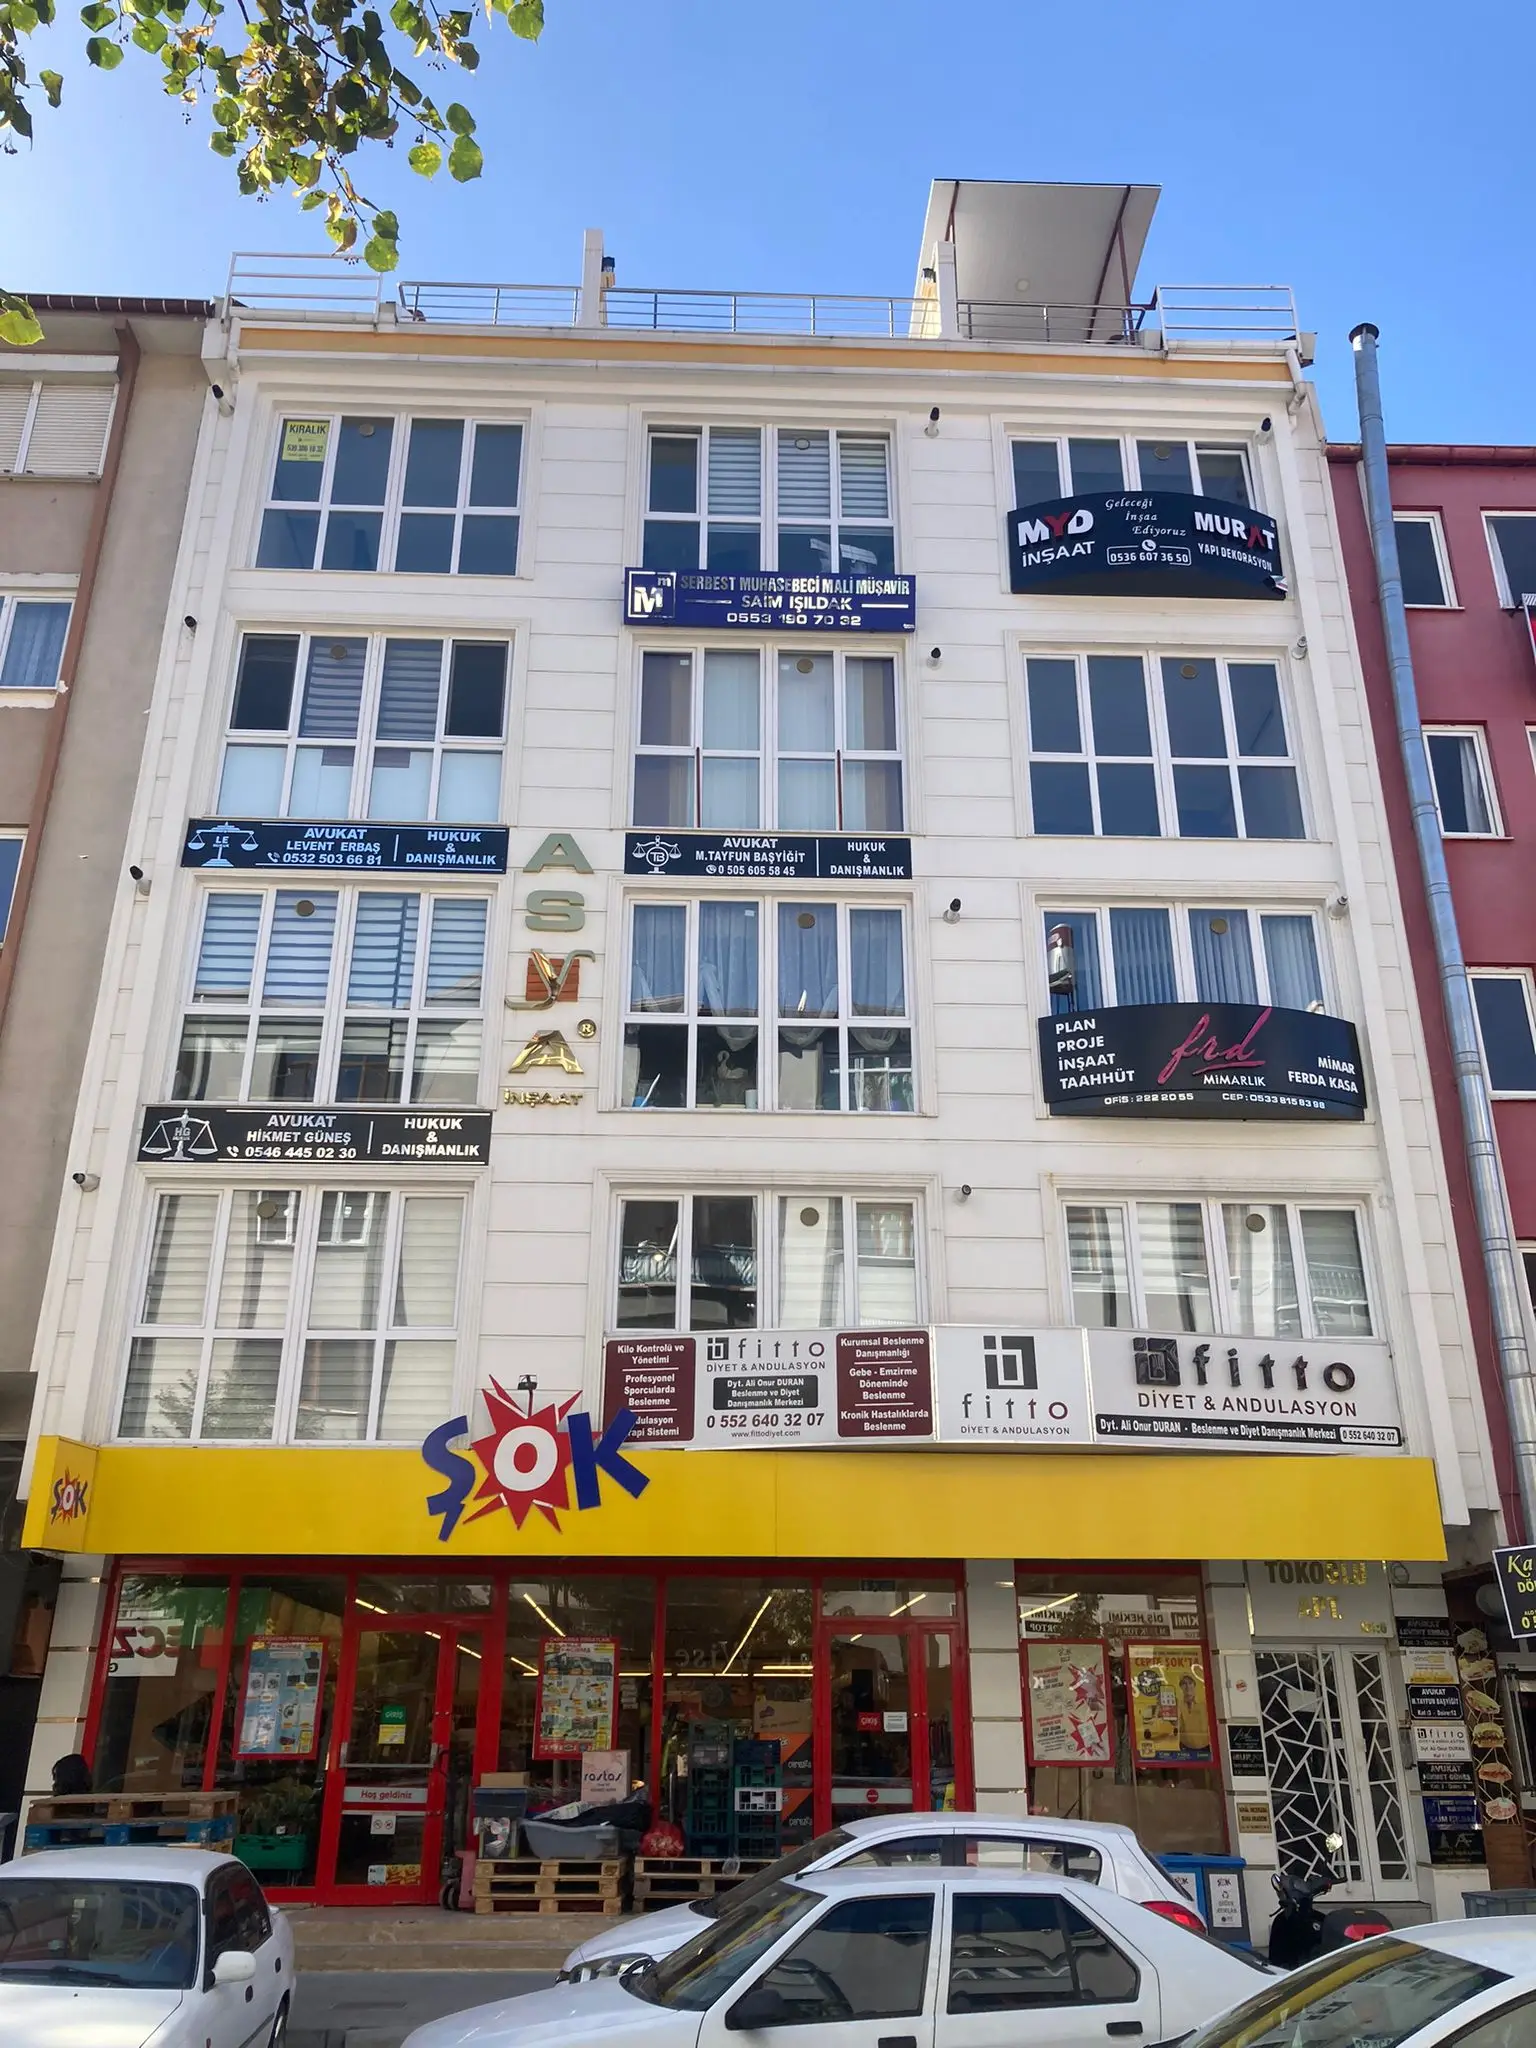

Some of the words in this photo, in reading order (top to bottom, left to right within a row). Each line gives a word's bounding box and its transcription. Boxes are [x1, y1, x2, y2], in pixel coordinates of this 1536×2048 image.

[1105, 498, 1153, 510] Geleceği
[1126, 511, 1157, 522] İnşaa
[1017, 510, 1094, 546] MYD
[1132, 525, 1187, 538] Ediyoruz
[1194, 511, 1276, 550] MURAT
[1022, 541, 1095, 567] İNŞAAT
[1110, 552, 1136, 562] 0536
[1139, 551, 1158, 561] 607
[1160, 552, 1174, 562] 36
[1176, 552, 1188, 563] 50
[1198, 543, 1218, 556] YAPI
[1220, 547, 1272, 572] DEKORASYON
[680, 575, 736, 592] SERBEST
[740, 575, 820, 594] MUHASEBECİ
[822, 577, 853, 595] MALİ
[855, 577, 910, 598] MÜŞAVİR
[741, 592, 782, 609] SAİM
[790, 596, 852, 614] IŞILDAK
[726, 612, 772, 624] 0553
[814, 614, 834, 625] 70
[840, 616, 861, 626] 32
[304, 828, 368, 840] AVUKAT
[427, 830, 482, 842] HUKUK
[286, 840, 333, 852] LEVENT
[340, 842, 380, 854] ERBAŞ
[445, 842, 456, 852] &
[723, 838, 778, 849] AVUKAT
[848, 842, 886, 852] HUKUK
[282, 853, 315, 863] 0532
[318, 854, 343, 864] 503
[347, 854, 363, 864] 66
[367, 855, 382, 865] 81
[406, 852, 496, 866] DANIŞMANLIK
[696, 851, 752, 862] M.TAYFUN
[754, 851, 806, 866] BAŞYİĞİT
[863, 854, 871, 863] &
[718, 866, 724, 876] 0
[727, 866, 745, 876] 505
[748, 866, 768, 876] 605
[768, 866, 781, 876] 58
[783, 866, 795, 877] 45
[830, 865, 904, 878] DANIŞMANLIK
[1056, 1018, 1096, 1034] PLAN
[1057, 1036, 1104, 1053] PROJE
[1058, 1052, 1116, 1072] İNŞAAT
[1317, 1055, 1356, 1075] MİMAR
[1060, 1070, 1135, 1090] TAAHHÜT
[1203, 1074, 1266, 1087] MİMARLIK
[1288, 1070, 1326, 1087] FERDA
[1328, 1076, 1358, 1094] KASA
[504, 1088, 584, 1108] İNŞAAT
[1136, 1094, 1159, 1103] 222
[1161, 1093, 1177, 1102] 20
[1178, 1092, 1194, 1101] 55
[1250, 1094, 1278, 1104] 0533
[1280, 1096, 1298, 1106] 815
[266, 1115, 336, 1128] AVUKAT
[404, 1117, 463, 1130] HUKUK
[246, 1130, 301, 1142] HİKMET
[305, 1130, 352, 1146] GÜNEŞ
[426, 1132, 438, 1142] &
[245, 1146, 281, 1158] 0546
[284, 1146, 314, 1158] 445
[316, 1147, 334, 1158] 02
[338, 1148, 356, 1159] 30
[381, 1143, 480, 1158] DANIŞMANLIK
[841, 1336, 880, 1347] Kurumsal
[883, 1336, 924, 1346] Beslenme
[618, 1344, 638, 1354] Kilo
[638, 1343, 672, 1354] Kontrolü
[674, 1345, 685, 1353] ve
[738, 1338, 825, 1358] fitto
[856, 1347, 910, 1358] Danışmanlığı
[632, 1354, 670, 1366] Yönetimi
[706, 1362, 739, 1372] DİYET
[740, 1363, 748, 1371] &
[750, 1361, 826, 1371] ANDULASYON
[849, 1366, 871, 1376] Gebe
[880, 1366, 918, 1376] Emzirme
[1192, 1343, 1356, 1392] fitto
[626, 1374, 675, 1386] Profesyonel
[728, 1379, 744, 1388] Dyt.
[746, 1378, 755, 1387] Ali
[756, 1378, 775, 1387] Onur
[778, 1378, 804, 1386] DURAN
[859, 1378, 909, 1388] Döneminde
[624, 1384, 676, 1396] Sporcularda
[732, 1389, 768, 1398] Beslenme
[781, 1388, 800, 1398] Diyet
[862, 1390, 906, 1400] Beslenme
[628, 1396, 670, 1407] Beslenme
[728, 1399, 772, 1408] Danışmanlık
[774, 1398, 804, 1406] Merkezi
[961, 1392, 1069, 1420] fitto
[1138, 1388, 1197, 1409] DİYET
[1204, 1395, 1216, 1410] &
[1223, 1396, 1358, 1416] ANDULASYON
[840, 1410, 868, 1420] Kronik
[870, 1408, 929, 1418] Hastalıklarda
[706, 1416, 716, 1429] 0
[720, 1416, 748, 1428] 552
[752, 1414, 778, 1428] 640
[784, 1414, 802, 1426] 32
[806, 1412, 825, 1426] 07
[864, 1420, 906, 1431] Beslenme
[647, 1427, 680, 1436] Sistemi
[732, 1429, 801, 1439] www.fittodiyet.com
[961, 1424, 991, 1434] DİYET
[992, 1426, 1000, 1434] &
[1002, 1426, 1070, 1435] ANDULASYON
[1100, 1419, 1119, 1432] Dyt.
[1122, 1418, 1132, 1430] Ali
[1134, 1420, 1152, 1432] Onur
[1154, 1420, 1181, 1434] DURAN
[1192, 1422, 1226, 1435] Beslenme
[1229, 1426, 1238, 1436] ve
[1240, 1424, 1260, 1439] Diyet
[1262, 1425, 1306, 1439] Danışmanlık
[1308, 1426, 1336, 1439] Merkezi
[1342, 1429, 1347, 1439] 0
[1350, 1429, 1362, 1440] 552
[1364, 1430, 1376, 1440] 640
[1378, 1431, 1386, 1441] 32
[1388, 1432, 1396, 1442] 07
[422, 1408, 651, 1542] ŞOK
[51, 1478, 88, 1525] ŞOK
[1422, 1688, 1446, 1696] AVUKAT
[1430, 1728, 1464, 1738] fitto
[360, 1790, 378, 1801] Hoş
[380, 1790, 412, 1802] geldiniz
